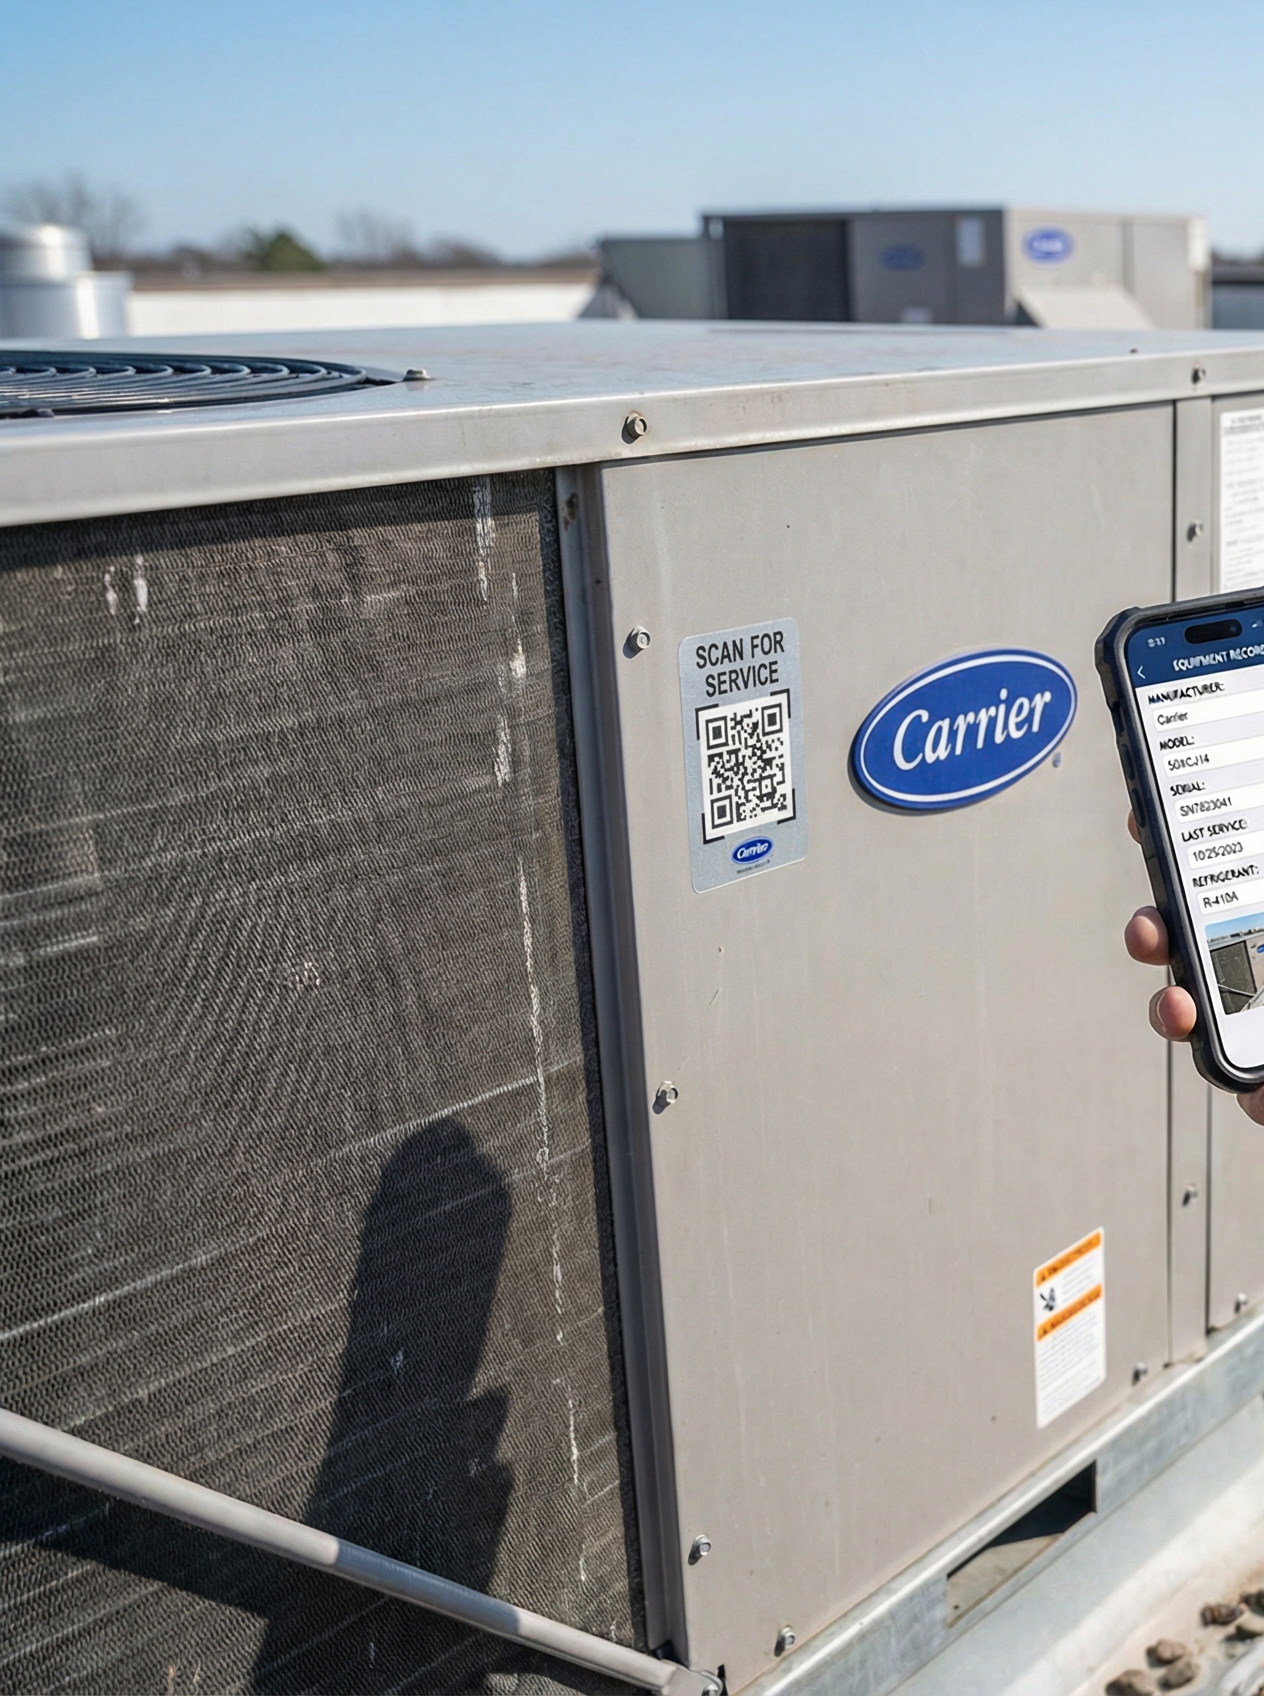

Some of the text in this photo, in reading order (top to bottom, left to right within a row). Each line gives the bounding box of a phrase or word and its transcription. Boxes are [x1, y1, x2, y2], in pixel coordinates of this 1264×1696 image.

[695, 630, 785, 669] SCAN FOR
[705, 660, 779, 698] SERVICE
[893, 688, 1052, 771] Carrier
[1181, 827, 1205, 843] LAST
